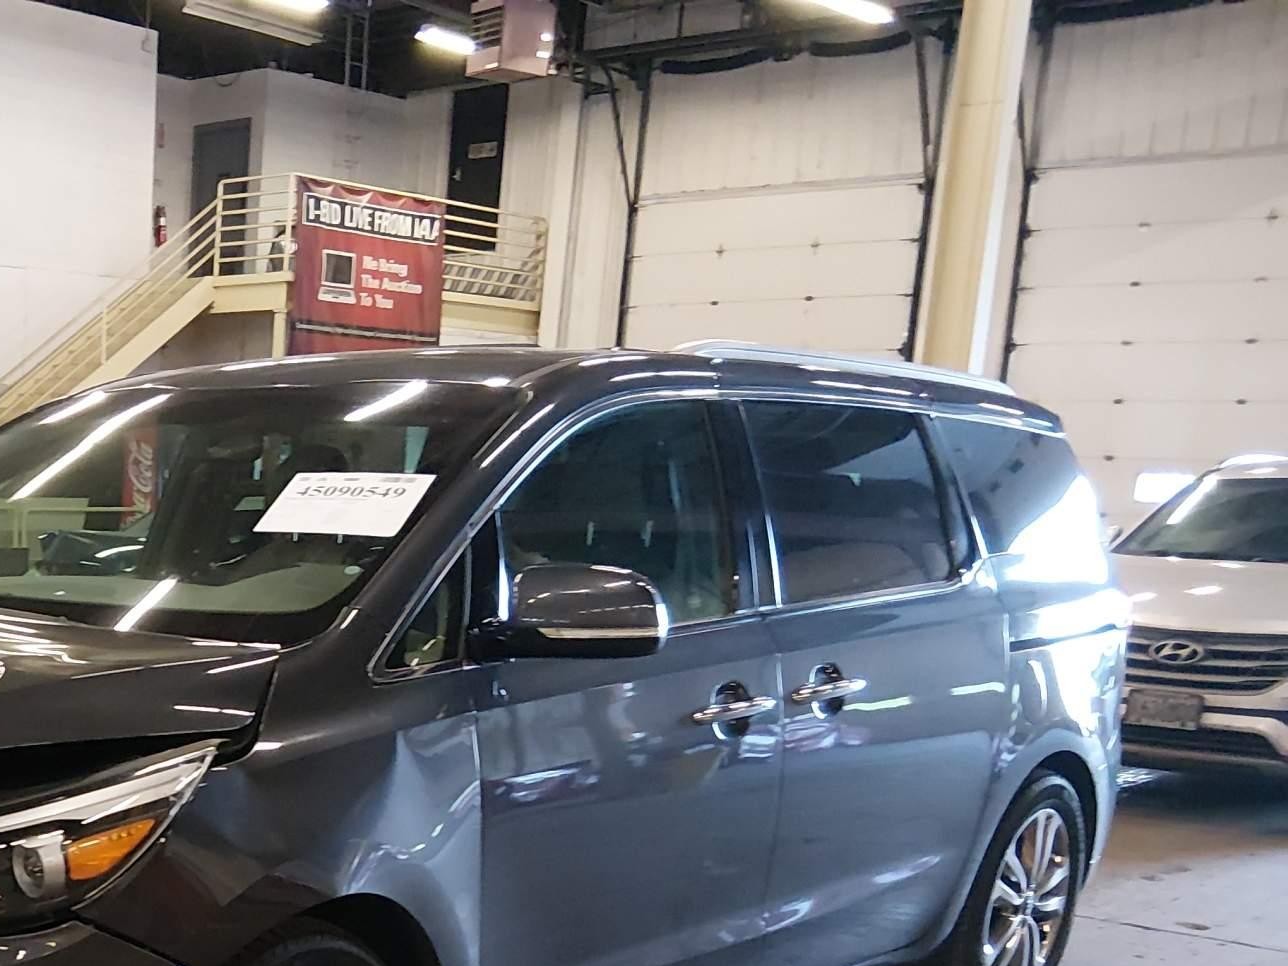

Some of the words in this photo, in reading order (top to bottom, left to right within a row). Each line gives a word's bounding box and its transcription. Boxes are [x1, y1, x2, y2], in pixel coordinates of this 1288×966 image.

[344, 205, 372, 231] LIVE
[373, 211, 412, 237] FROM
[361, 274, 380, 288] The
[381, 277, 422, 294] Auction
[360, 292, 373, 307] To
[374, 293, 394, 309] You
[295, 485, 407, 499] 45090549
